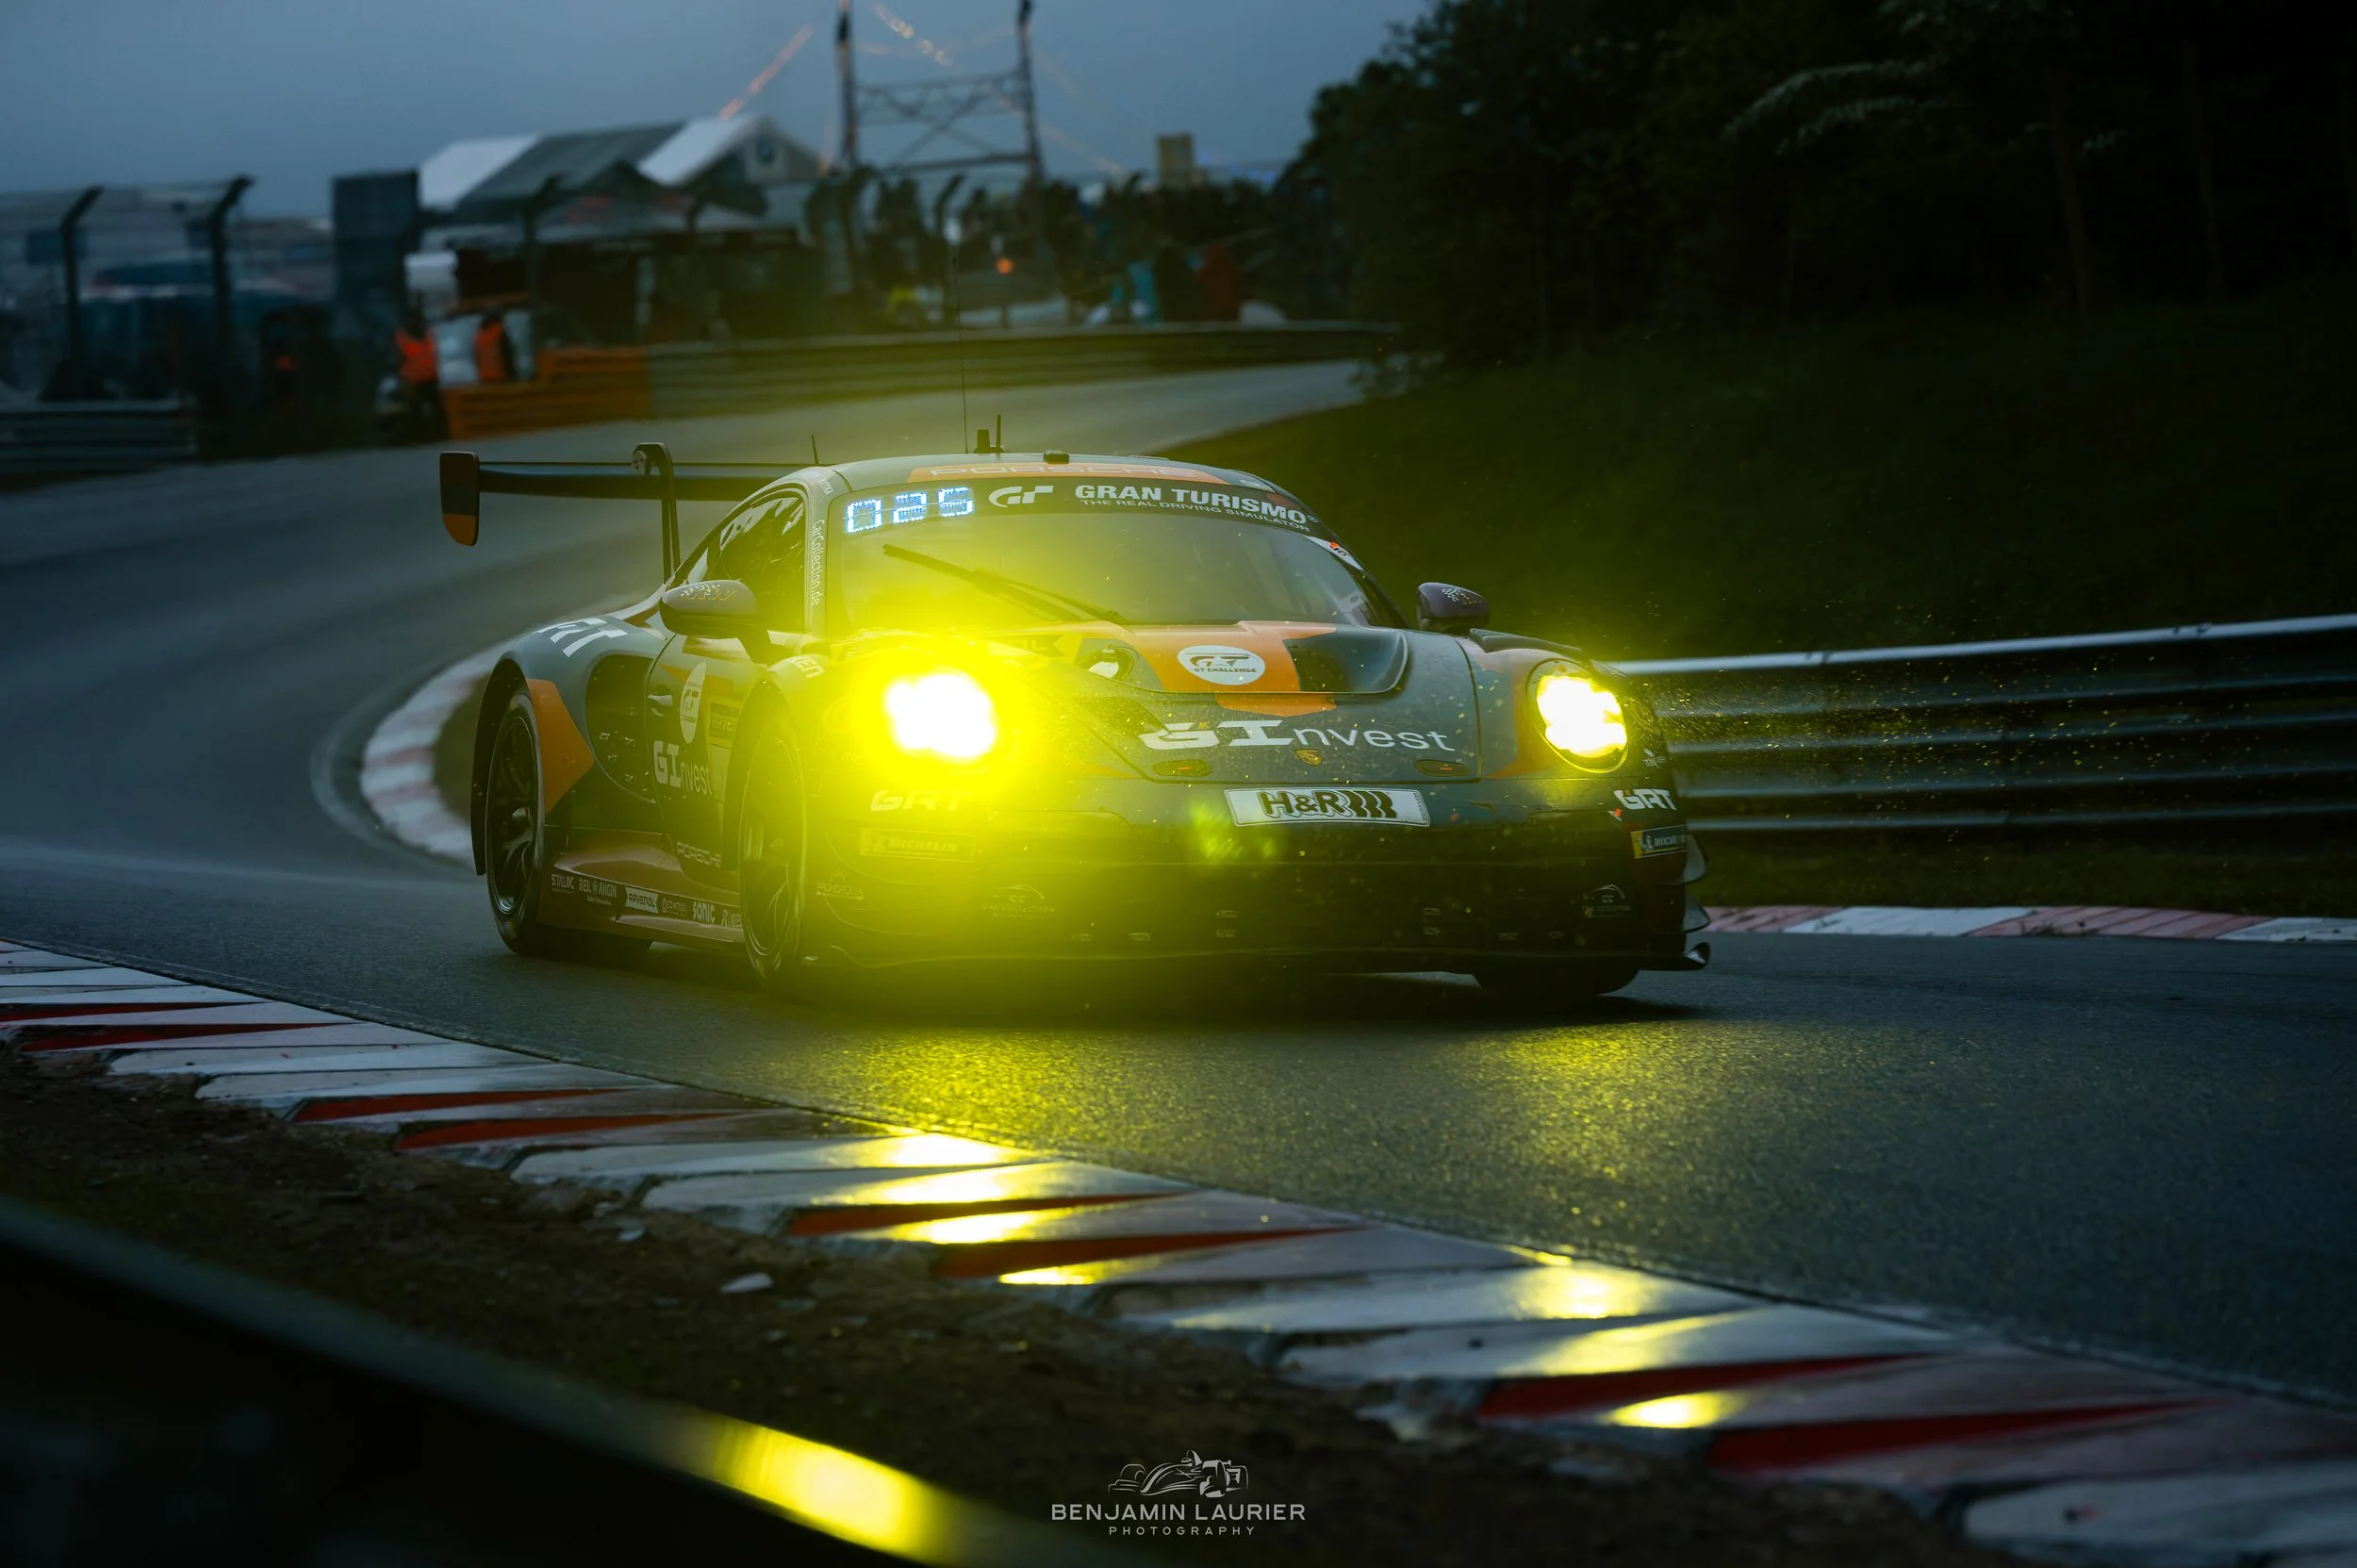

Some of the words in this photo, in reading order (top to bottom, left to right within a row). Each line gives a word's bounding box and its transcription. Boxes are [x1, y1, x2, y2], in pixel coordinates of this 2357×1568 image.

[930, 467, 1195, 478] PORSCHE
[1075, 484, 1161, 502] GRAN
[845, 486, 975, 534] 025
[1159, 502, 1223, 514] DRIVING
[1225, 509, 1310, 532] SIMULATOR
[811, 520, 825, 606] CarCollection.de
